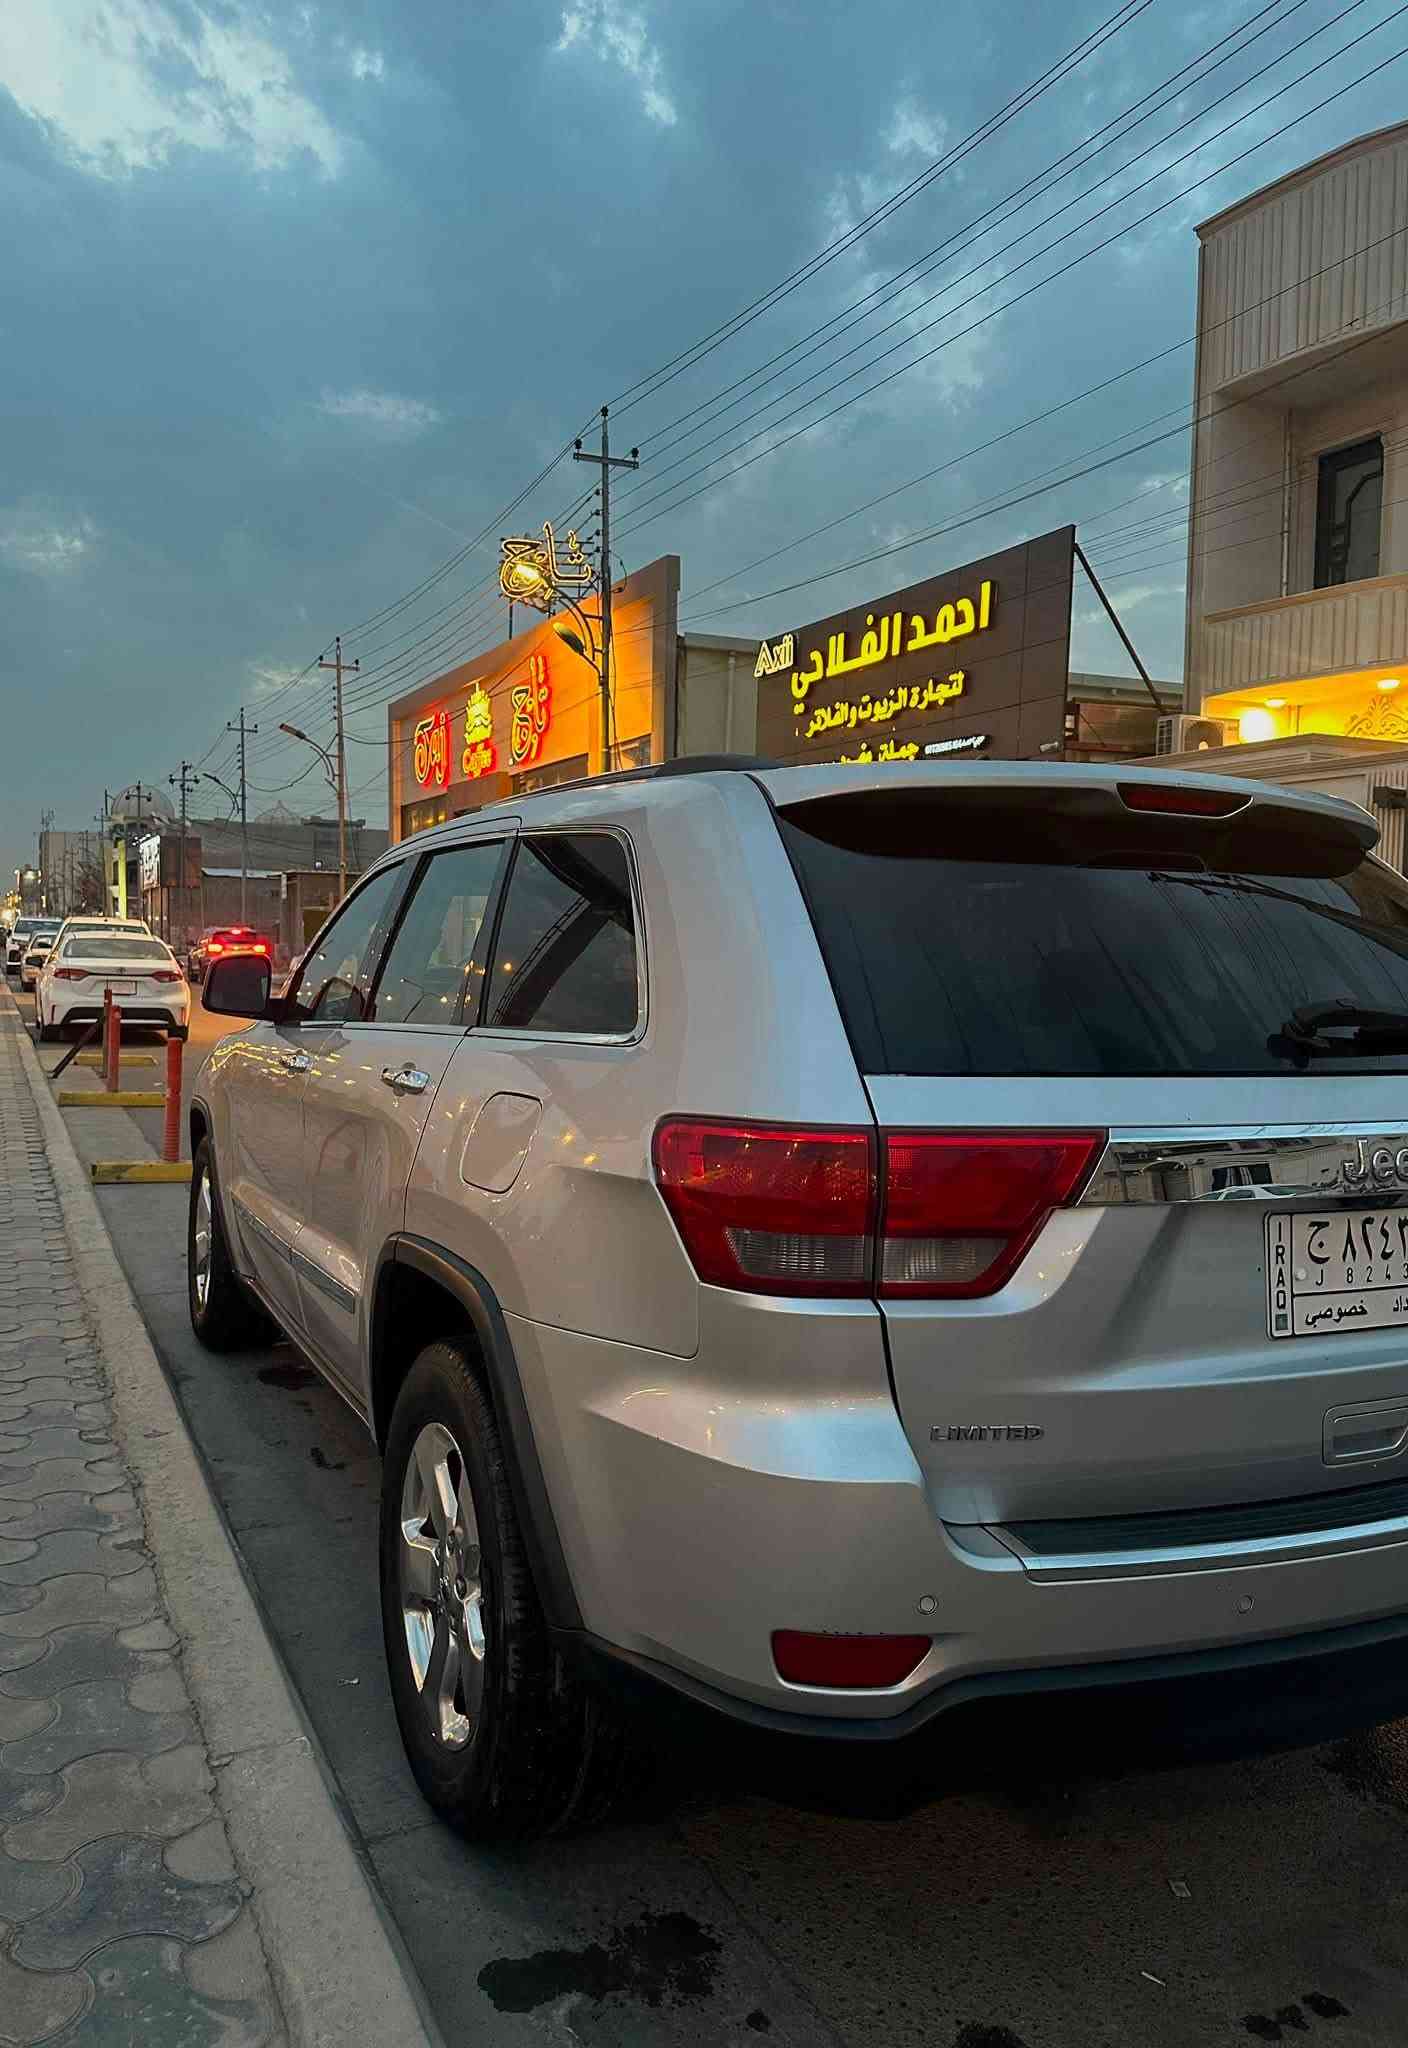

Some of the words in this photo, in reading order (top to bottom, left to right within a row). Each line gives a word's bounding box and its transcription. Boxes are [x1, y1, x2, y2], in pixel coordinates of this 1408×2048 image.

[906, 580, 992, 651] احمد
[791, 613, 903, 716] الفلاحي
[858, 687, 908, 722] الزيوت
[908, 670, 965, 710] لتجارة
[1308, 1220, 1330, 1265] ج
[1275, 1221, 1287, 1310] IRAQ
[1305, 1300, 1368, 1328] خصوصي
[929, 1424, 1046, 1442] LIMITED
